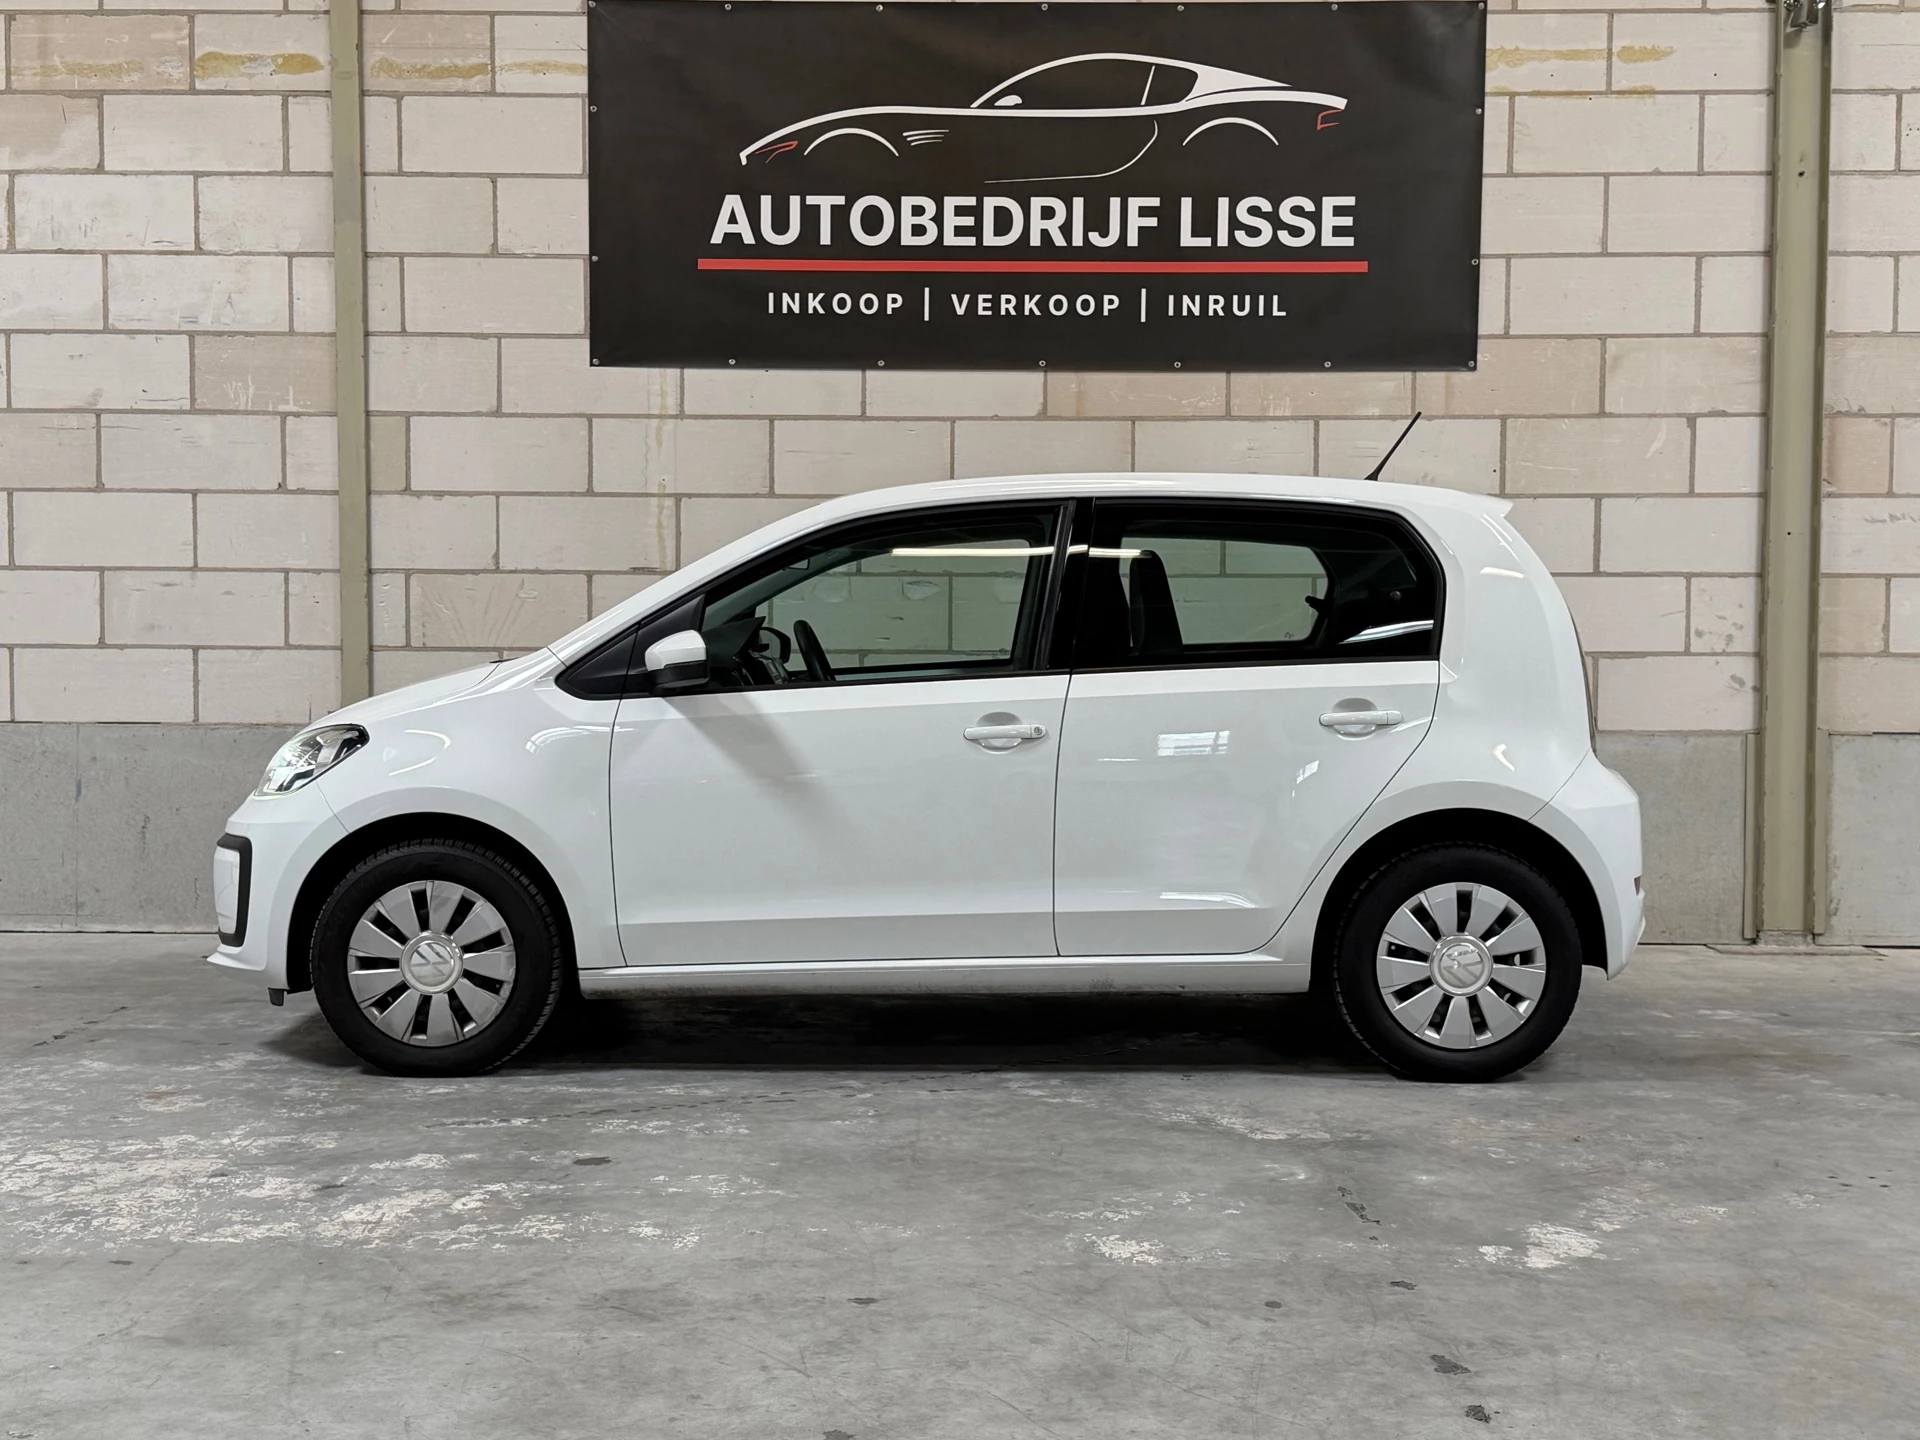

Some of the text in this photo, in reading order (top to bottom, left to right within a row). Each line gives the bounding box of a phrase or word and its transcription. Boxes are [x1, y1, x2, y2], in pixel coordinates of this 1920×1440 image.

[709, 194, 1356, 248] AUTOBEDRIJF LISSE
[768, 292, 1287, 317] INKOOP VERKOOP INRUIL
